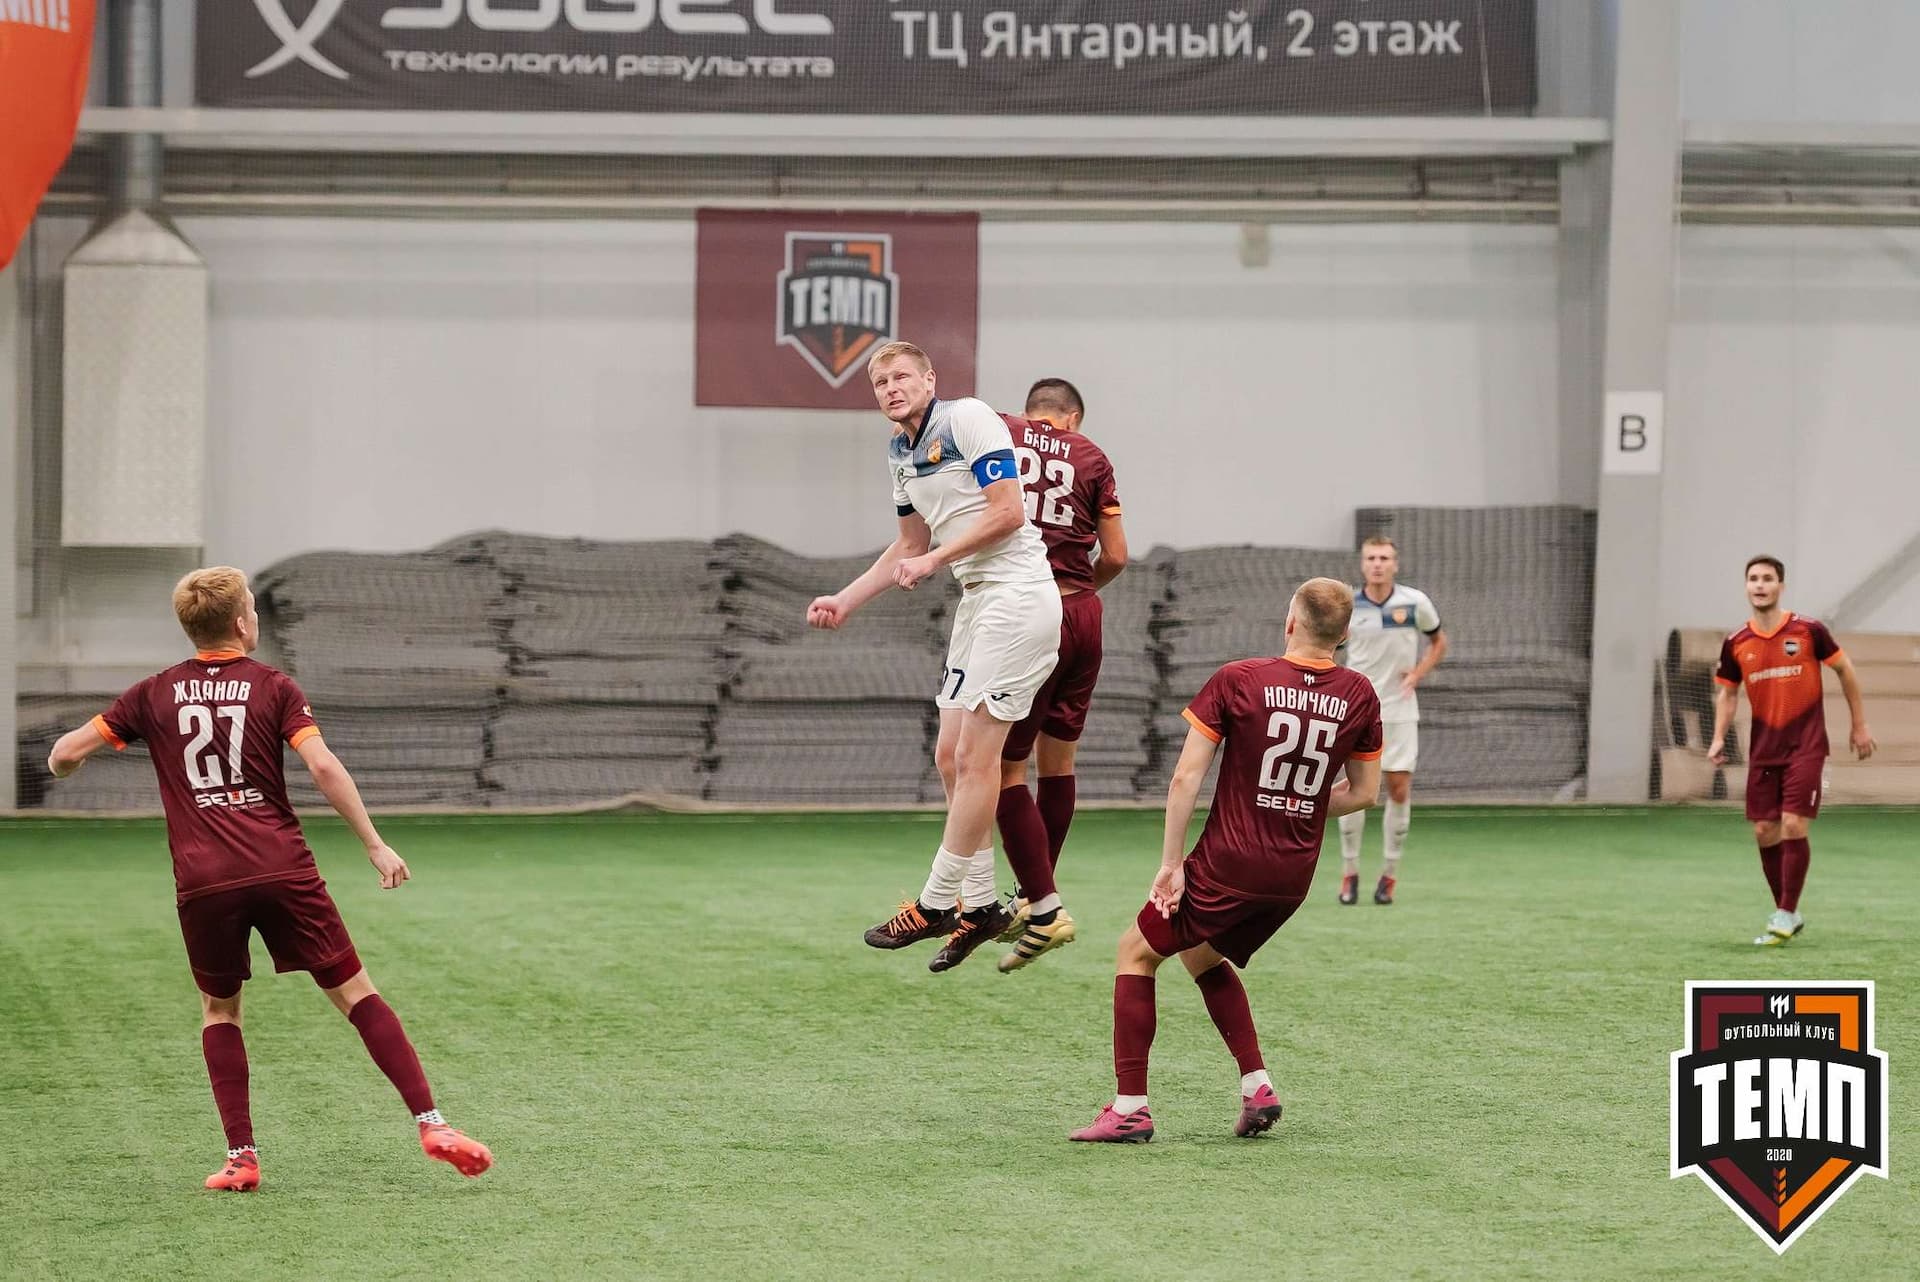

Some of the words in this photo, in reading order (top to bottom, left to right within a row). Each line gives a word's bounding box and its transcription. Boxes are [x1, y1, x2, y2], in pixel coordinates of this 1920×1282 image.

[890, 10, 968, 68] ТЦ
[980, 9, 1268, 69] Янтарный,
[1286, 9, 1315, 57] 2
[1333, 19, 1464, 56] этаж
[384, 50, 608, 74] технологии
[615, 54, 835, 81] результата
[789, 275, 887, 331] ТЕМП
[1024, 427, 1071, 459] БАБИЧ
[172, 680, 251, 703] ЖДАНОВ
[1264, 686, 1348, 721] НОВИЧКОВ
[178, 705, 246, 789] 27
[1258, 711, 1339, 797] 25
